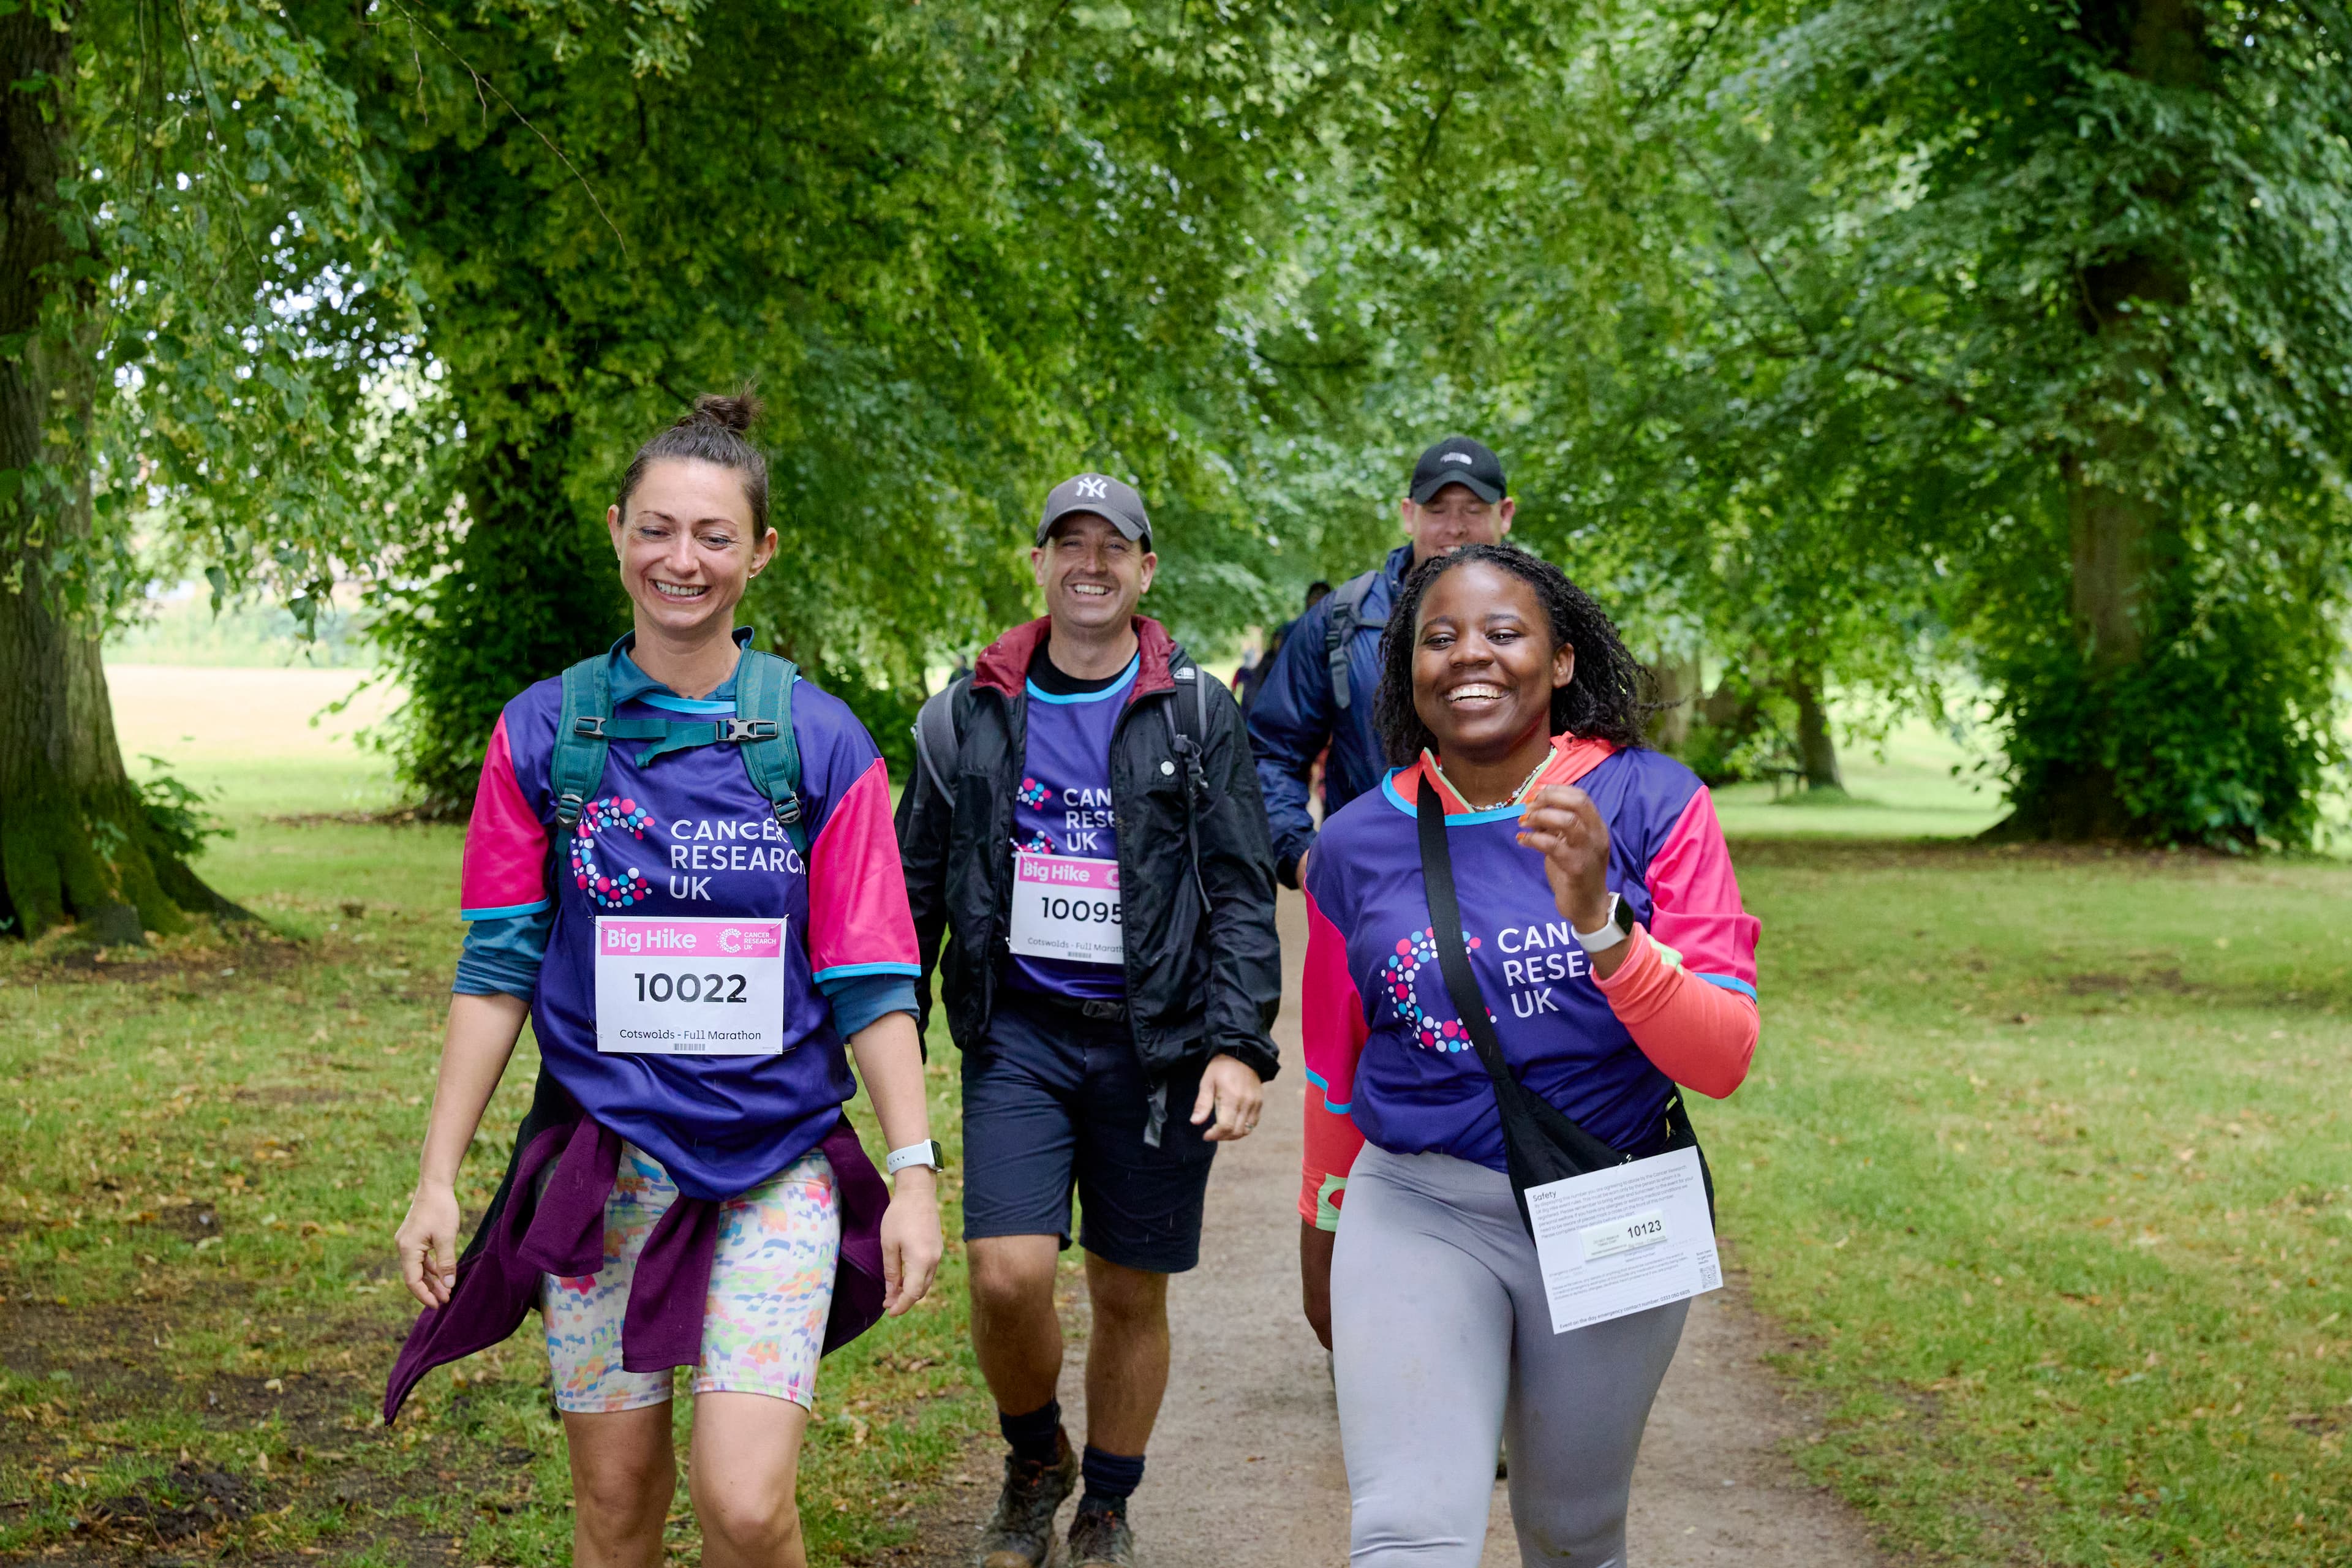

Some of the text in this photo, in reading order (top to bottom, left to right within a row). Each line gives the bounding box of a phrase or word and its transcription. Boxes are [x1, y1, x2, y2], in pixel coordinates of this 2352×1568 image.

[671, 818, 788, 843] CANCER
[1067, 832, 1098, 851] UK
[1023, 862, 1090, 883] Big Hike
[669, 875, 711, 901] UK
[1042, 897, 1122, 924] 10095
[607, 928, 696, 952] Big Hike
[1028, 937, 1069, 948] Cotswolds
[1503, 951, 1593, 987] RESE
[635, 973, 747, 1003] 10022
[1511, 987, 1559, 1018] UK
[620, 1029, 674, 1039] Cotswolds
[684, 1031, 705, 1039] Full
[708, 1031, 761, 1040] Marathon
[1532, 1191, 1556, 1201] Safety
[1627, 1219, 1662, 1238] 10123
